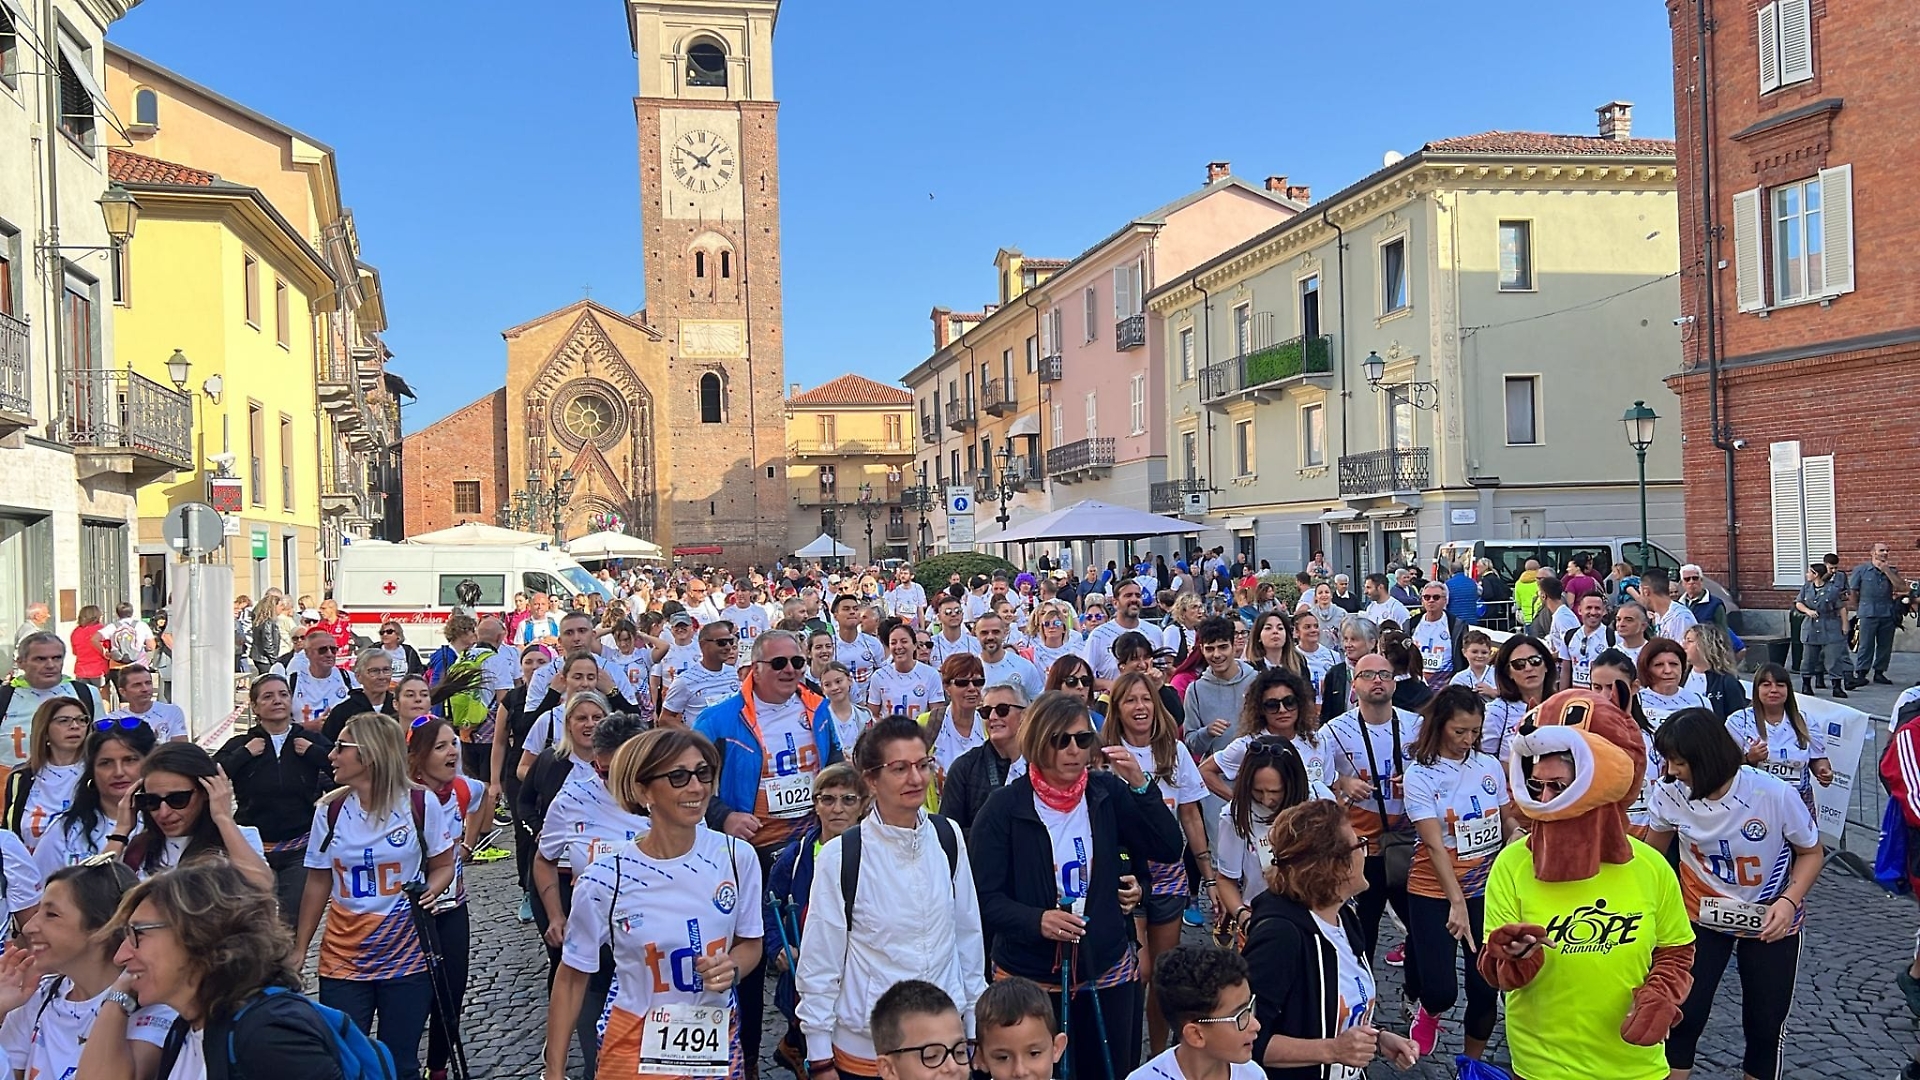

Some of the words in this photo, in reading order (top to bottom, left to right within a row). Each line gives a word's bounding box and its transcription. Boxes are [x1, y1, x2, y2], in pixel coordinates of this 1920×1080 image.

[379, 612, 408, 624] Croce
[411, 612, 442, 623] Rossa
[775, 787, 811, 806] 1022
[1821, 804, 1842, 818] SPORT
[1464, 825, 1499, 847] 1522
[333, 848, 403, 898] tdc
[1690, 840, 1763, 887] tdc
[1704, 898, 1719, 908] tdc
[1709, 909, 1763, 929] 1528
[1545, 914, 1644, 945] HOPE
[1560, 941, 1613, 955] Running
[650, 1006, 671, 1023] tdc
[657, 1026, 720, 1053] 1494
